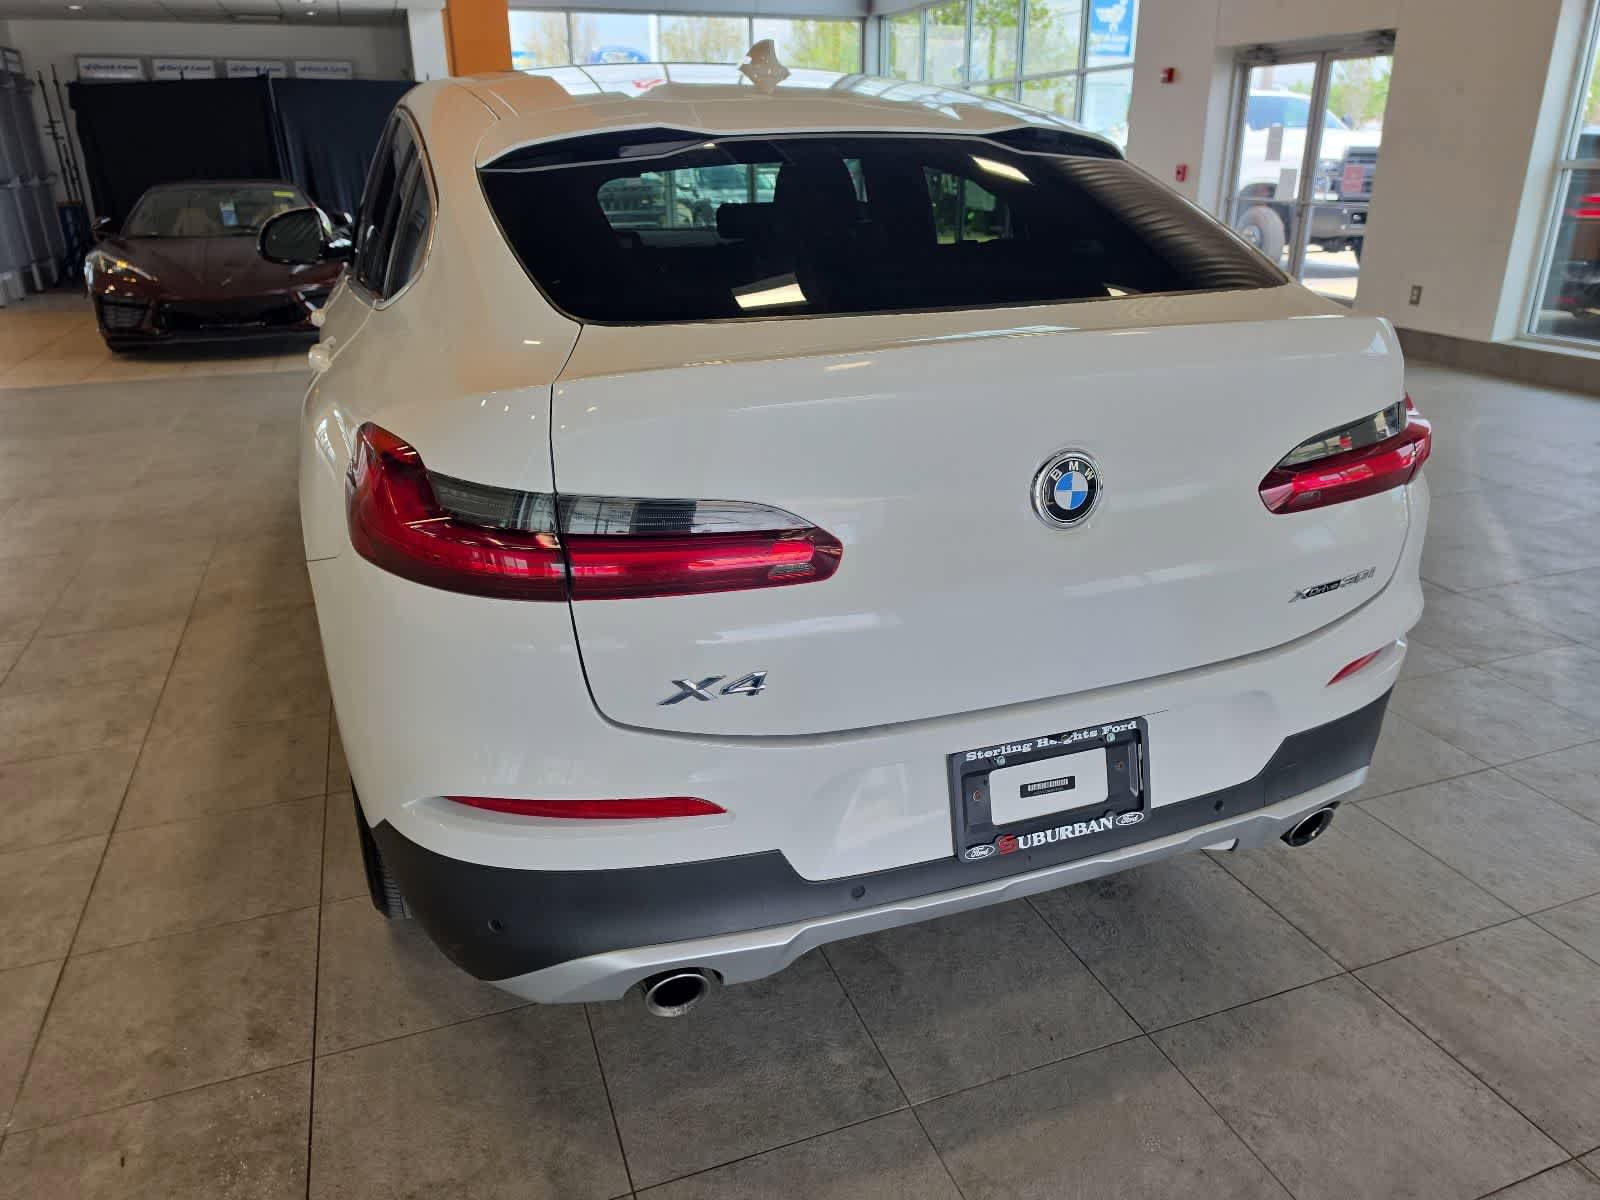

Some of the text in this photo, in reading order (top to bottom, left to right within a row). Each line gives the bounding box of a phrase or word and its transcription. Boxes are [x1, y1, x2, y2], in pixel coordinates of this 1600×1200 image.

[1049, 460, 1096, 481] BMW
[656, 669, 769, 706] X4
[965, 742, 1033, 762] Sterling
[1101, 720, 1138, 736] Ford
[998, 816, 1114, 855] SUBURBAN
